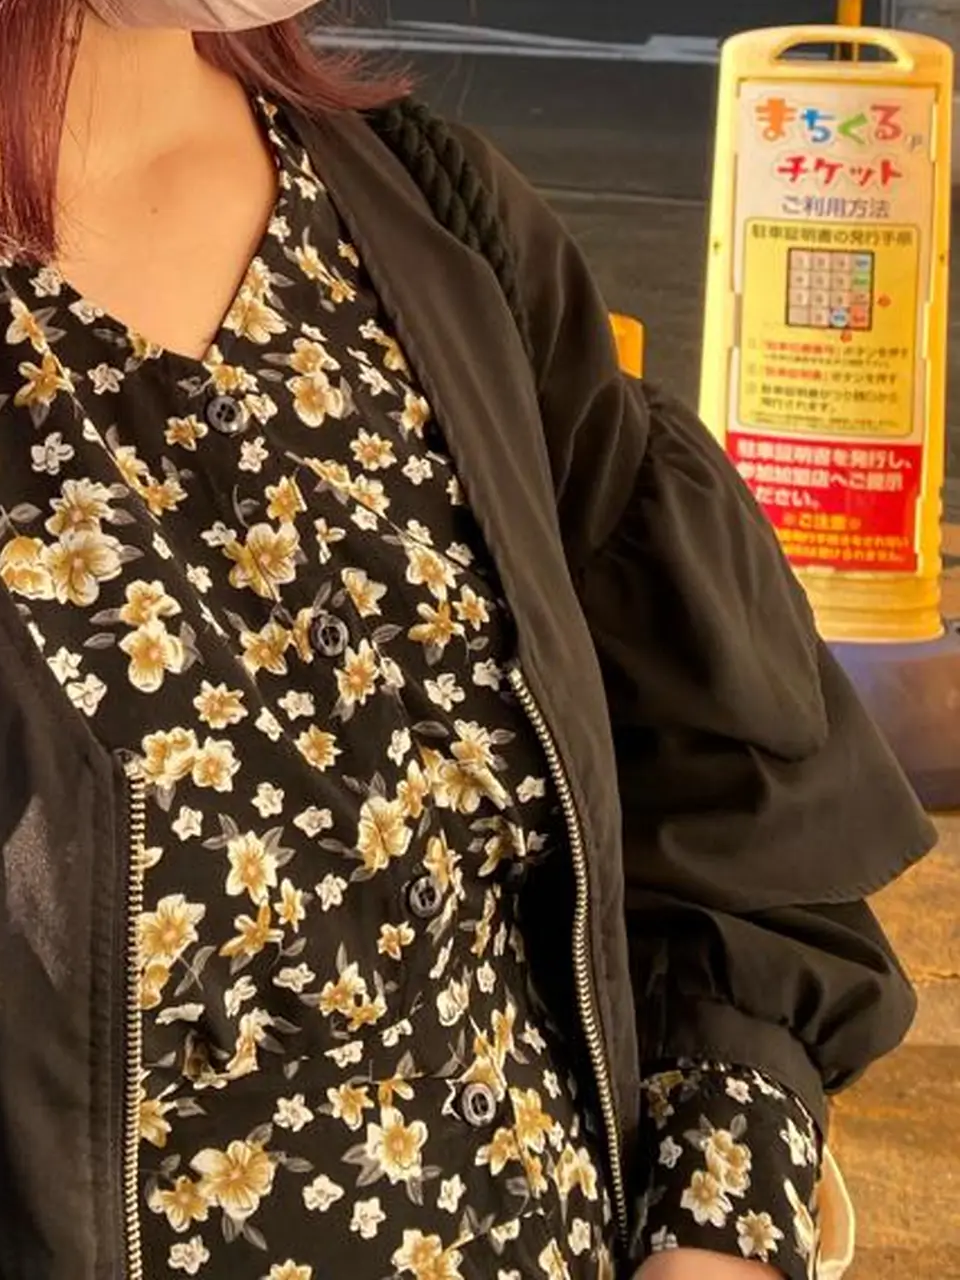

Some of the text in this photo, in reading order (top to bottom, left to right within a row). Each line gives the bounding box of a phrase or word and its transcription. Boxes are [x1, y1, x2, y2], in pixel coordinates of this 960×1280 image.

[755, 98, 902, 145] まちくる
[776, 155, 903, 187] チケット
[782, 194, 890, 219] ご利用方法
